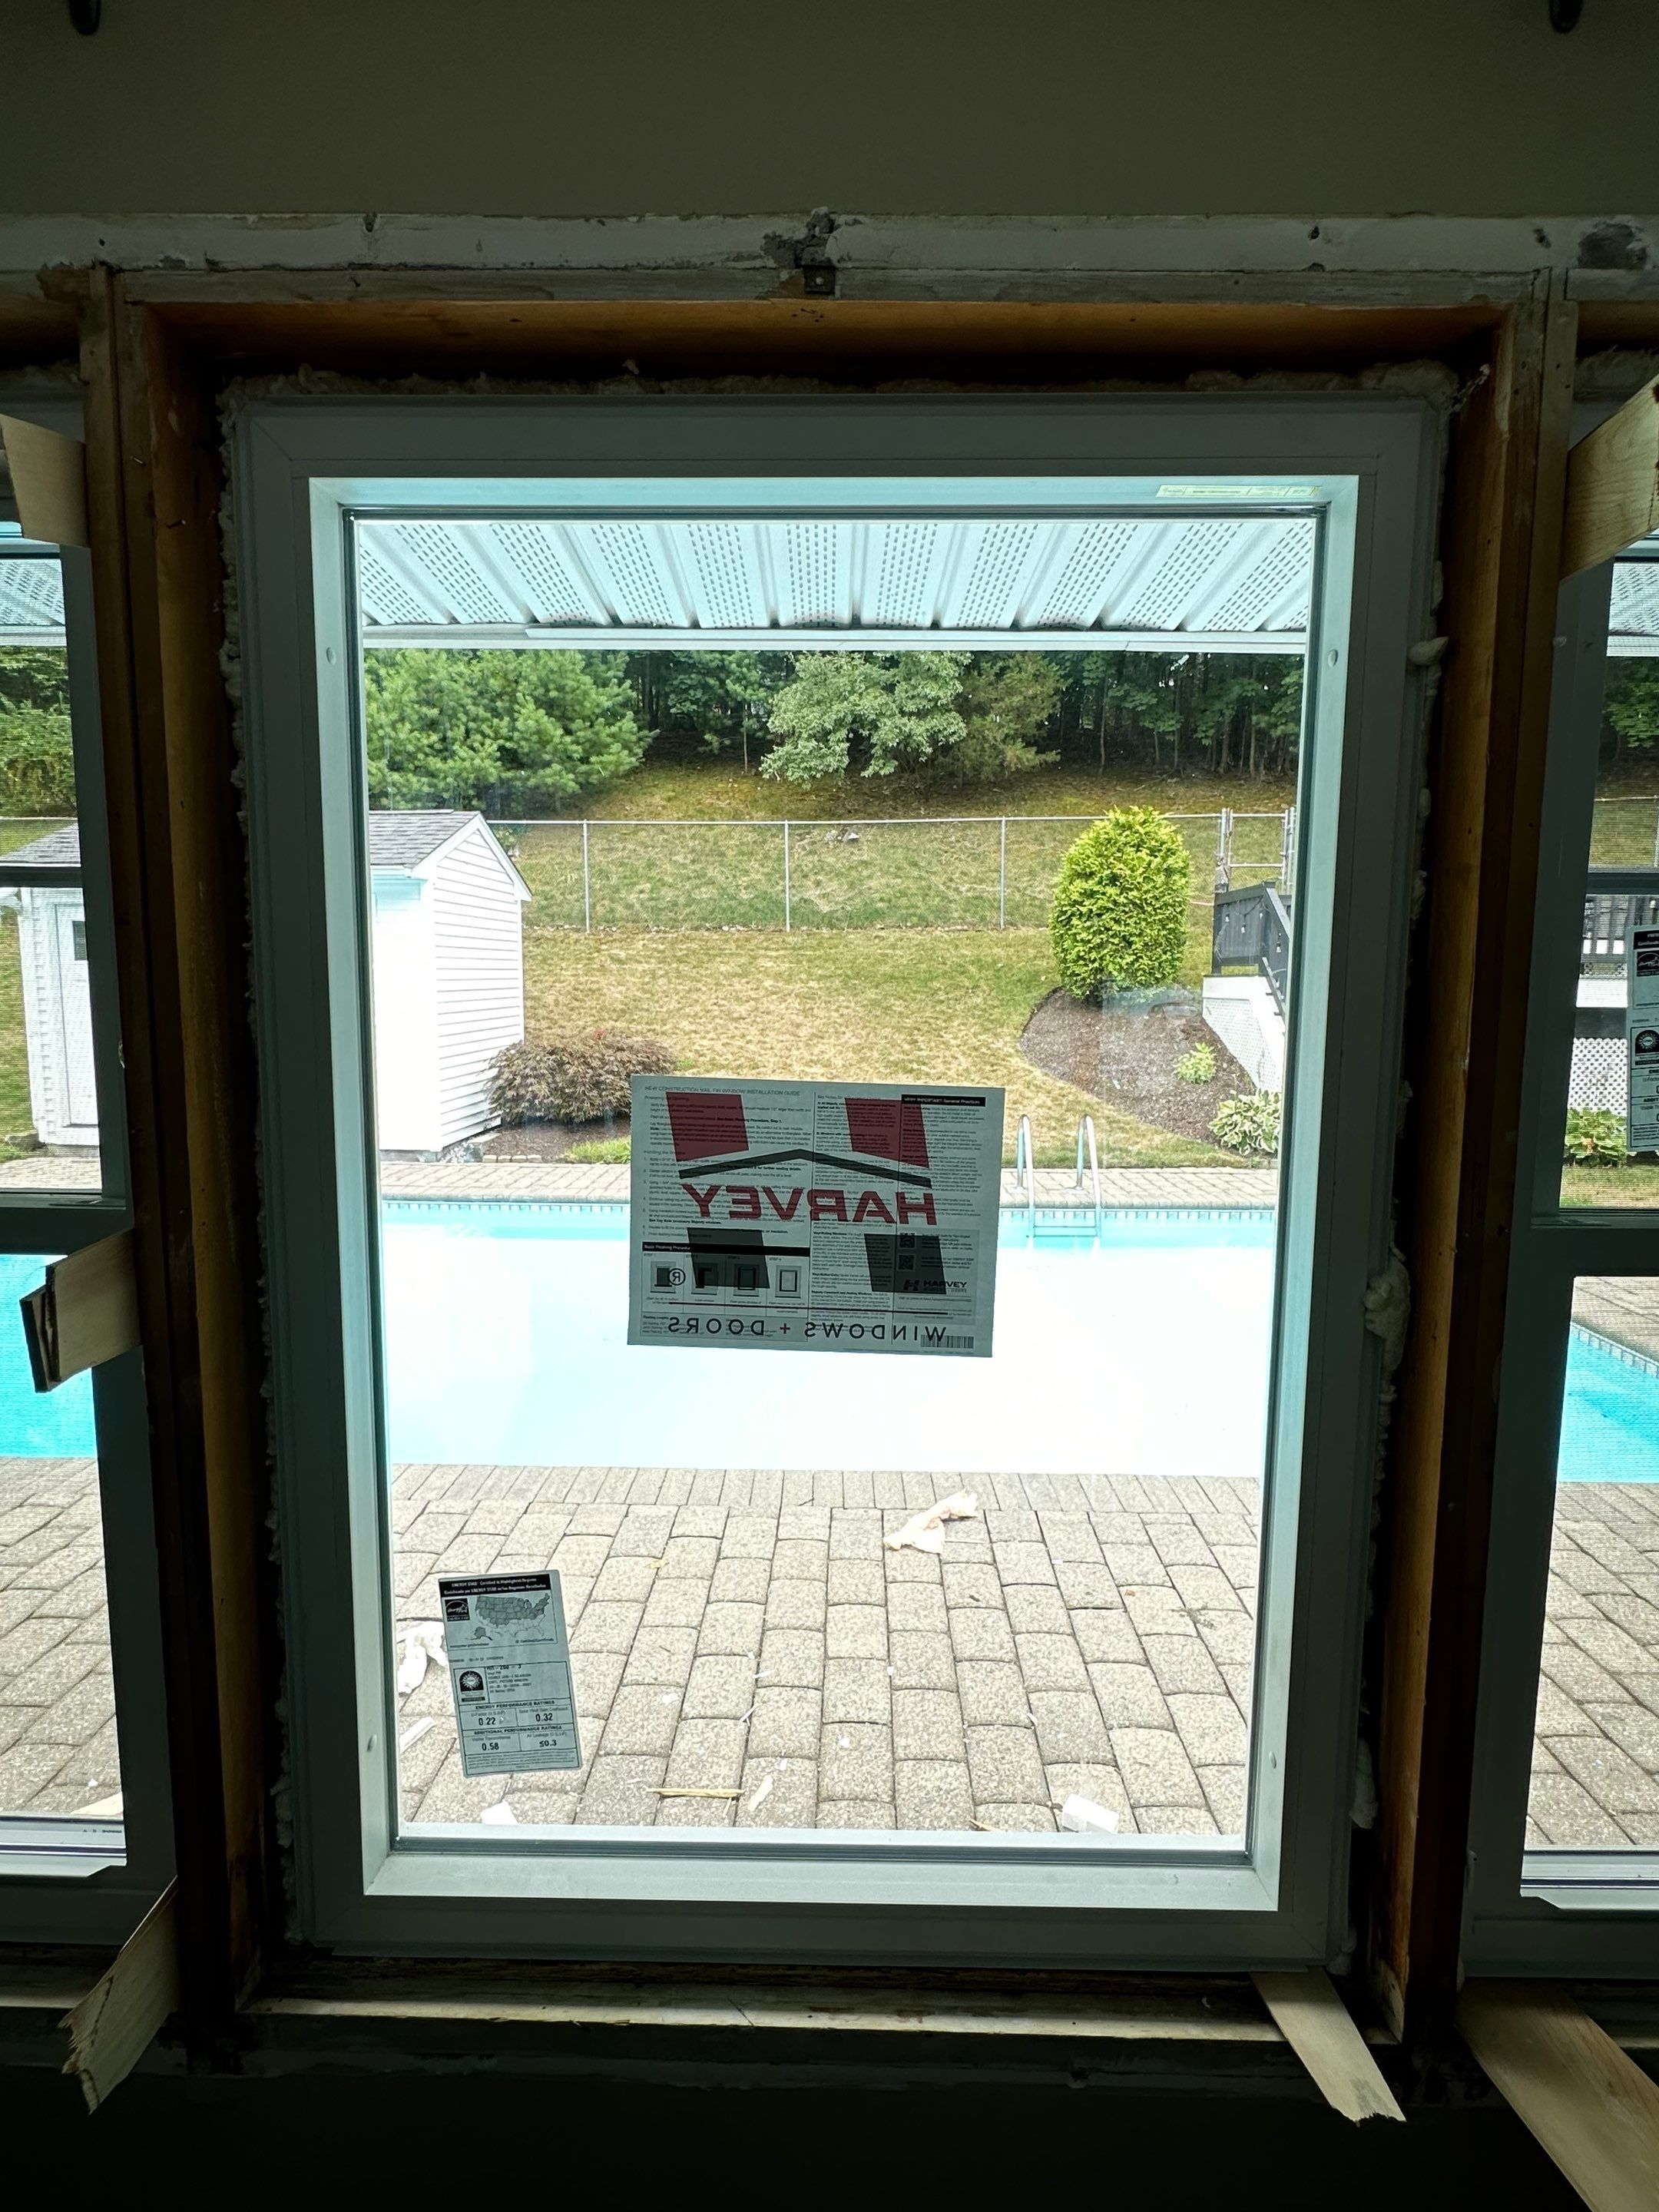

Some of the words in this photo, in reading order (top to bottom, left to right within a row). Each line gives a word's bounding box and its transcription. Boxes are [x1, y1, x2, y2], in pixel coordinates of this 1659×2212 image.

[923, 1280, 968, 1289] HARVEY
[478, 1717, 496, 1726] 0.22
[535, 1713, 553, 1722] 0.32
[482, 1742, 499, 1751] 0.58
